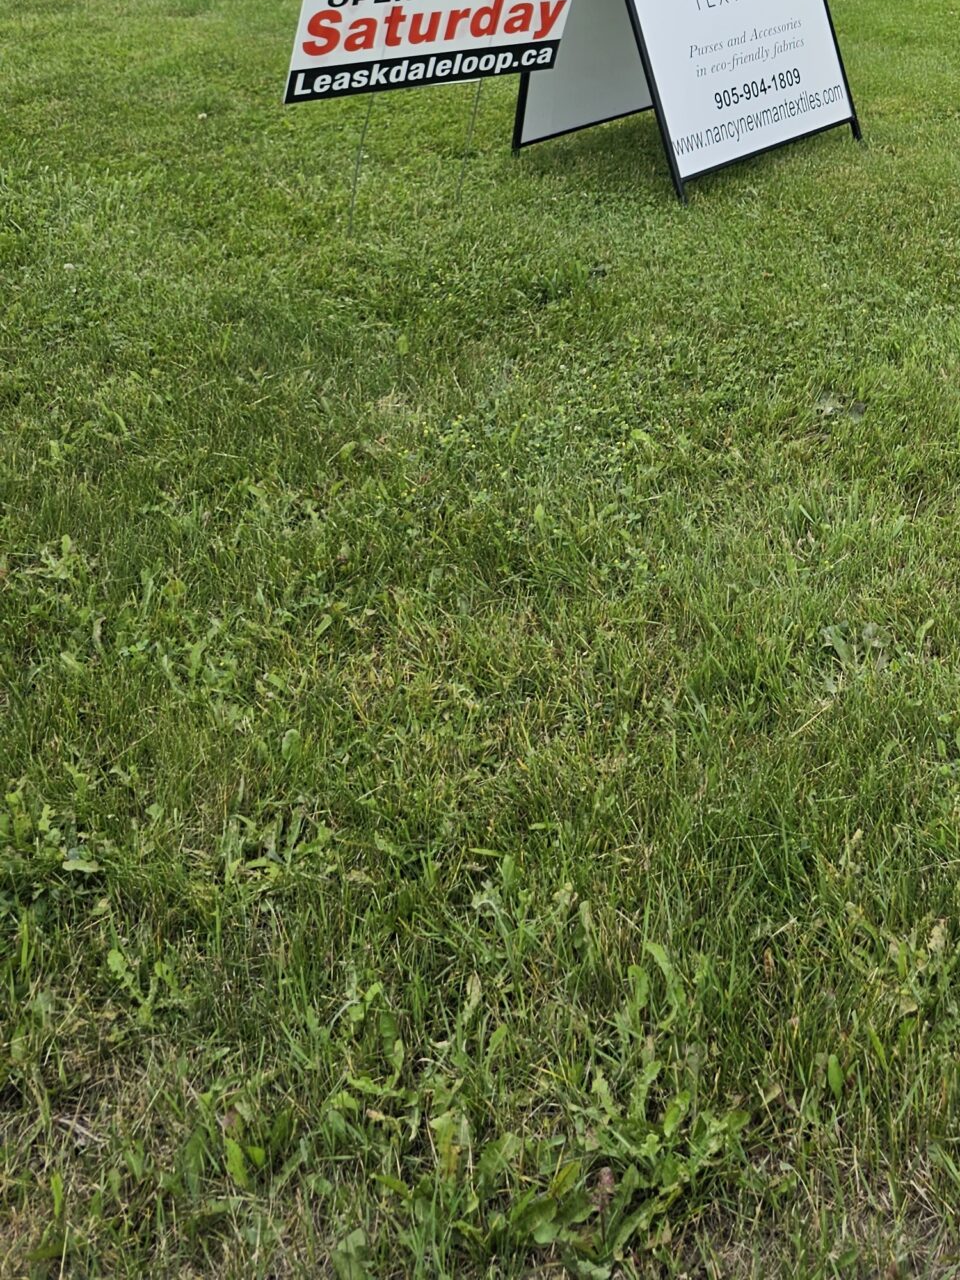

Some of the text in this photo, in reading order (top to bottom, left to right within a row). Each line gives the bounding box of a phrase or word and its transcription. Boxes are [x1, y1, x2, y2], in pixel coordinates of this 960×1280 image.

[689, 17, 803, 59] Purses and Accessories
[696, 36, 806, 78] in eco-friendly fabrics
[293, 45, 554, 97] Leaskdaleloop.ca
[714, 67, 802, 110] 905-904-1809
[672, 83, 844, 157] www.nancynewmantextiles.com
